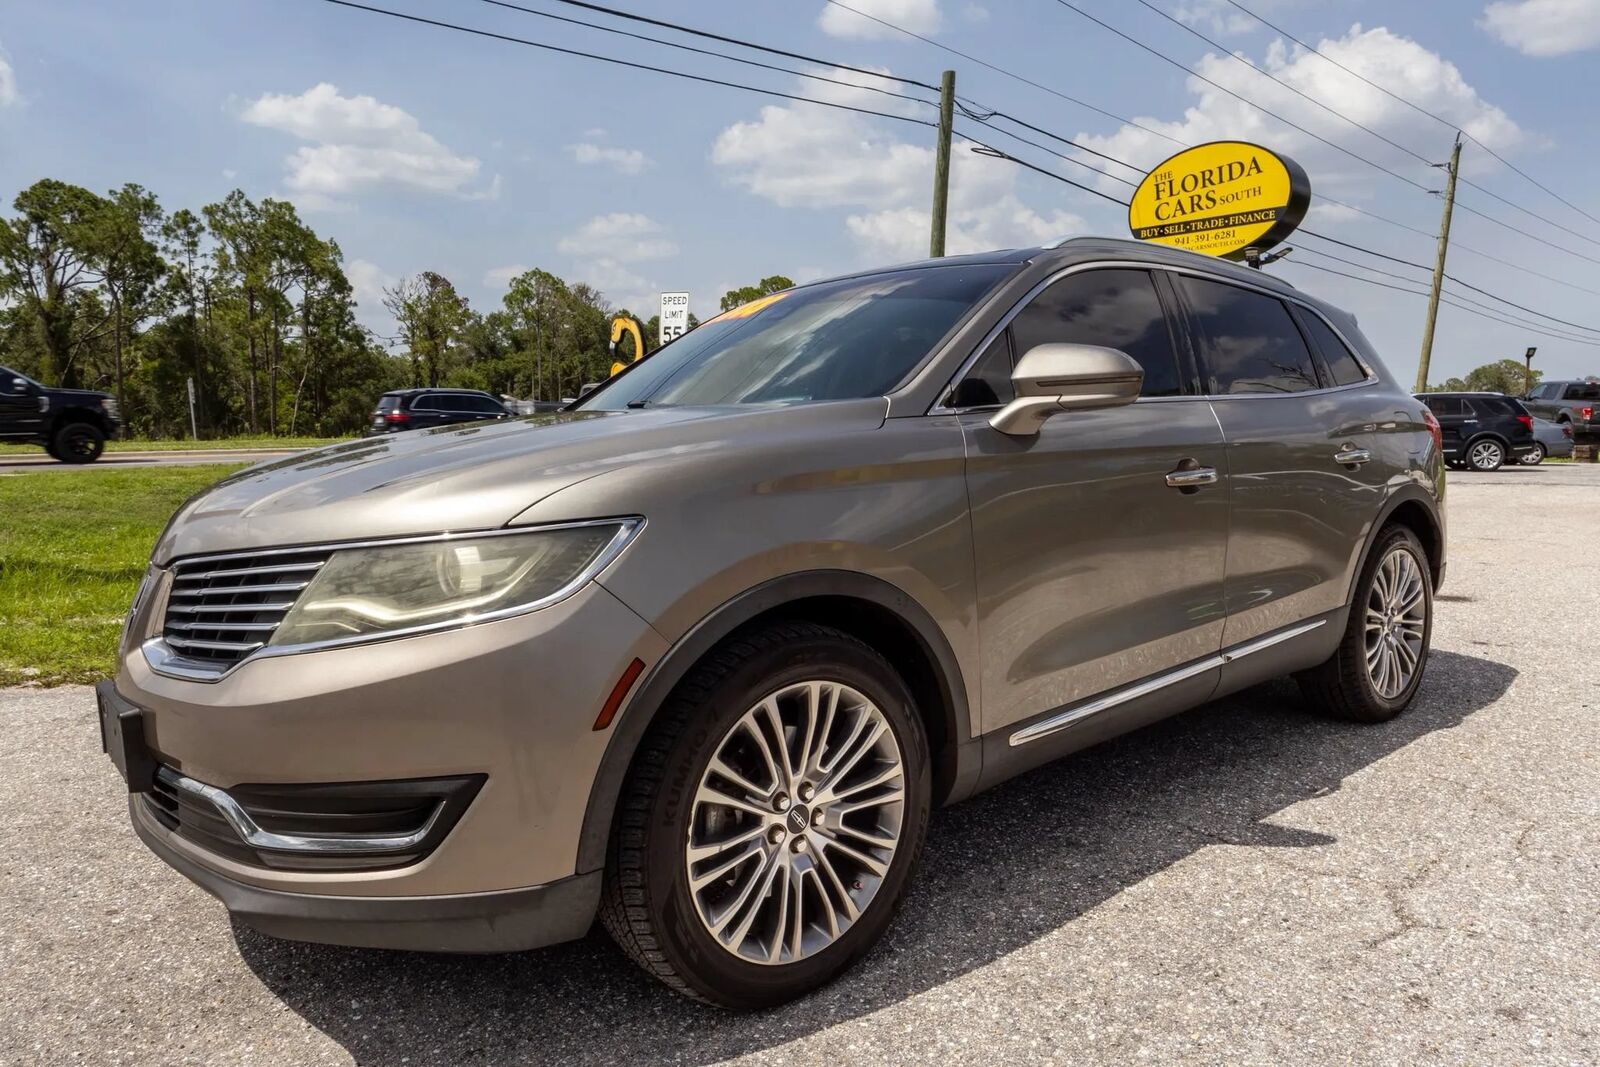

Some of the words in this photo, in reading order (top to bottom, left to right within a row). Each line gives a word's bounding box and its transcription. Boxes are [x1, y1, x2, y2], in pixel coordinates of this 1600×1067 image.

[1153, 171, 1173, 184] THE
[1154, 156, 1263, 201] FLORIDA
[1154, 190, 1217, 221] CARS
[1219, 186, 1262, 206] SOUTH
[1140, 227, 1160, 238] BUY
[1163, 223, 1186, 235] SELL
[1190, 217, 1225, 231] TRADE
[1229, 210, 1276, 226] FINANCE
[662, 296, 687, 305] SPEED
[664, 310, 684, 319] LIMIT
[663, 326, 682, 343] 55
